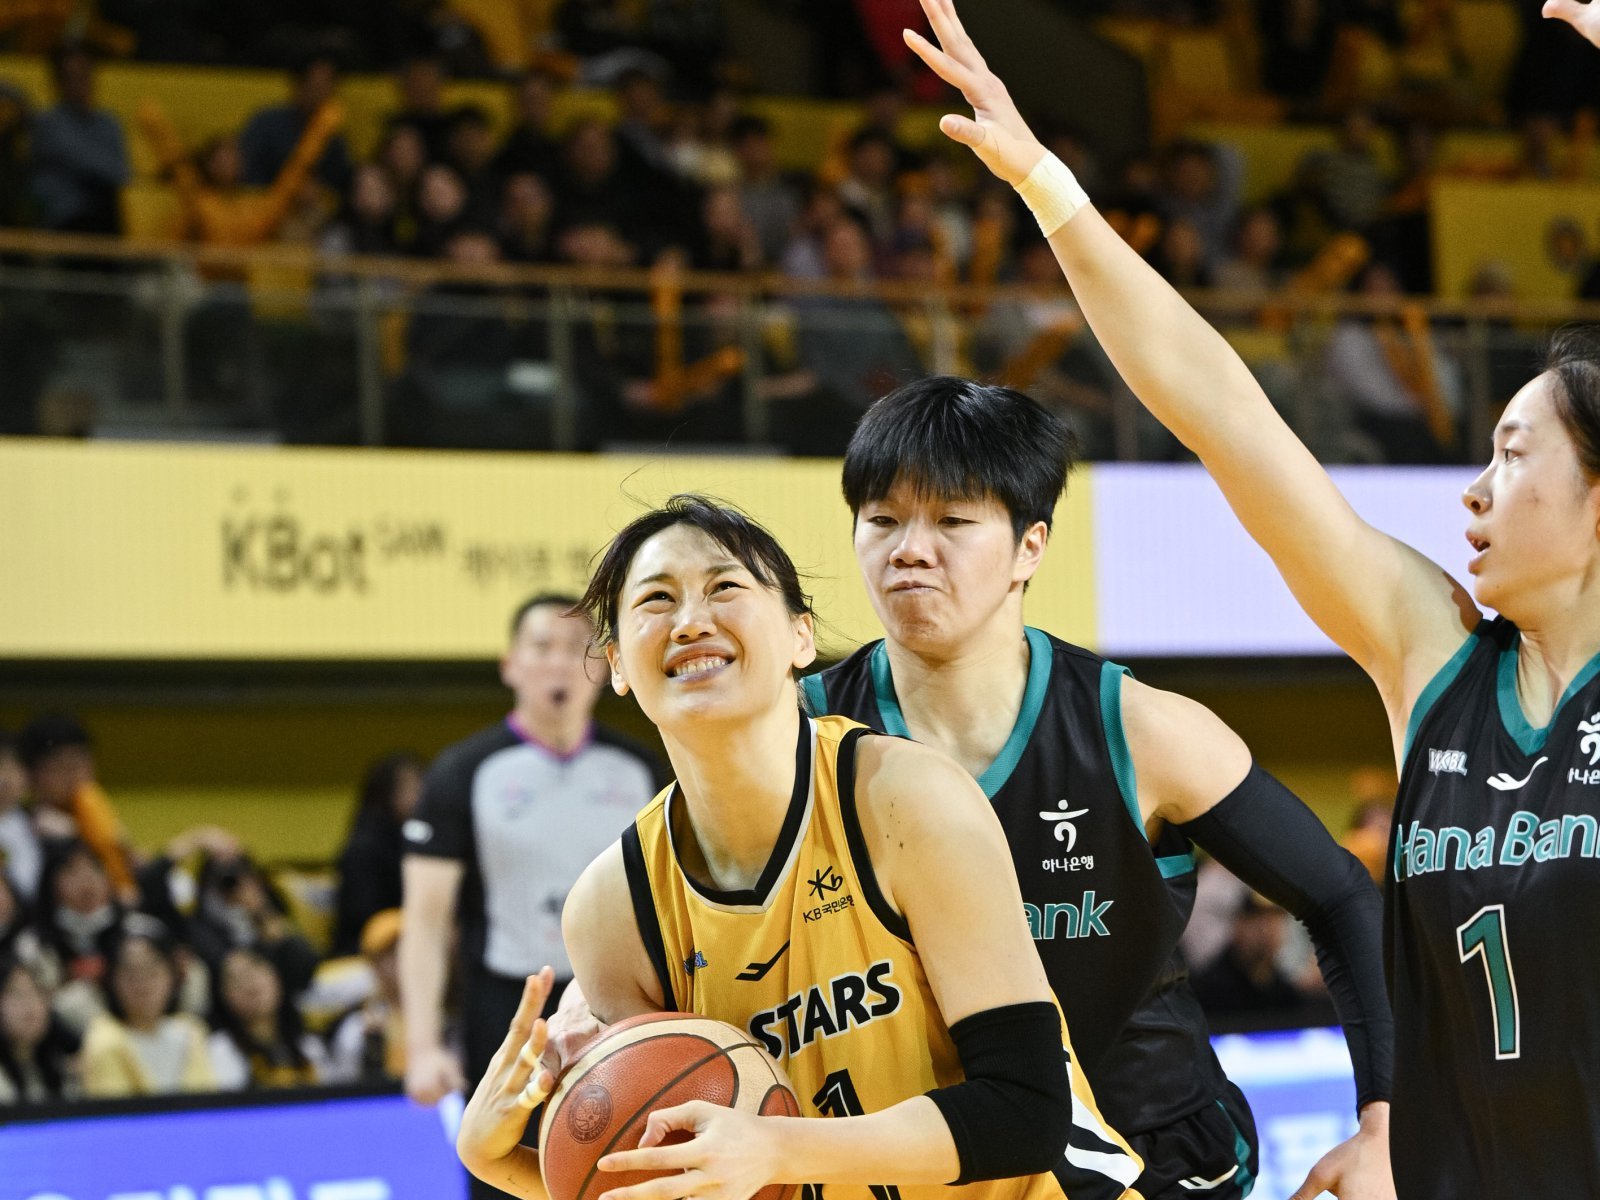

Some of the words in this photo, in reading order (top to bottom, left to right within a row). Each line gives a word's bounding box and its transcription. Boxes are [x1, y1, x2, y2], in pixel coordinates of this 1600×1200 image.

[1042, 855, 1094, 873] 하나은행
[1394, 820, 1495, 883] Hana
[1499, 810, 1600, 866] Ban
[748, 959, 903, 1062] STARS
[1456, 904, 1520, 1060] 1
